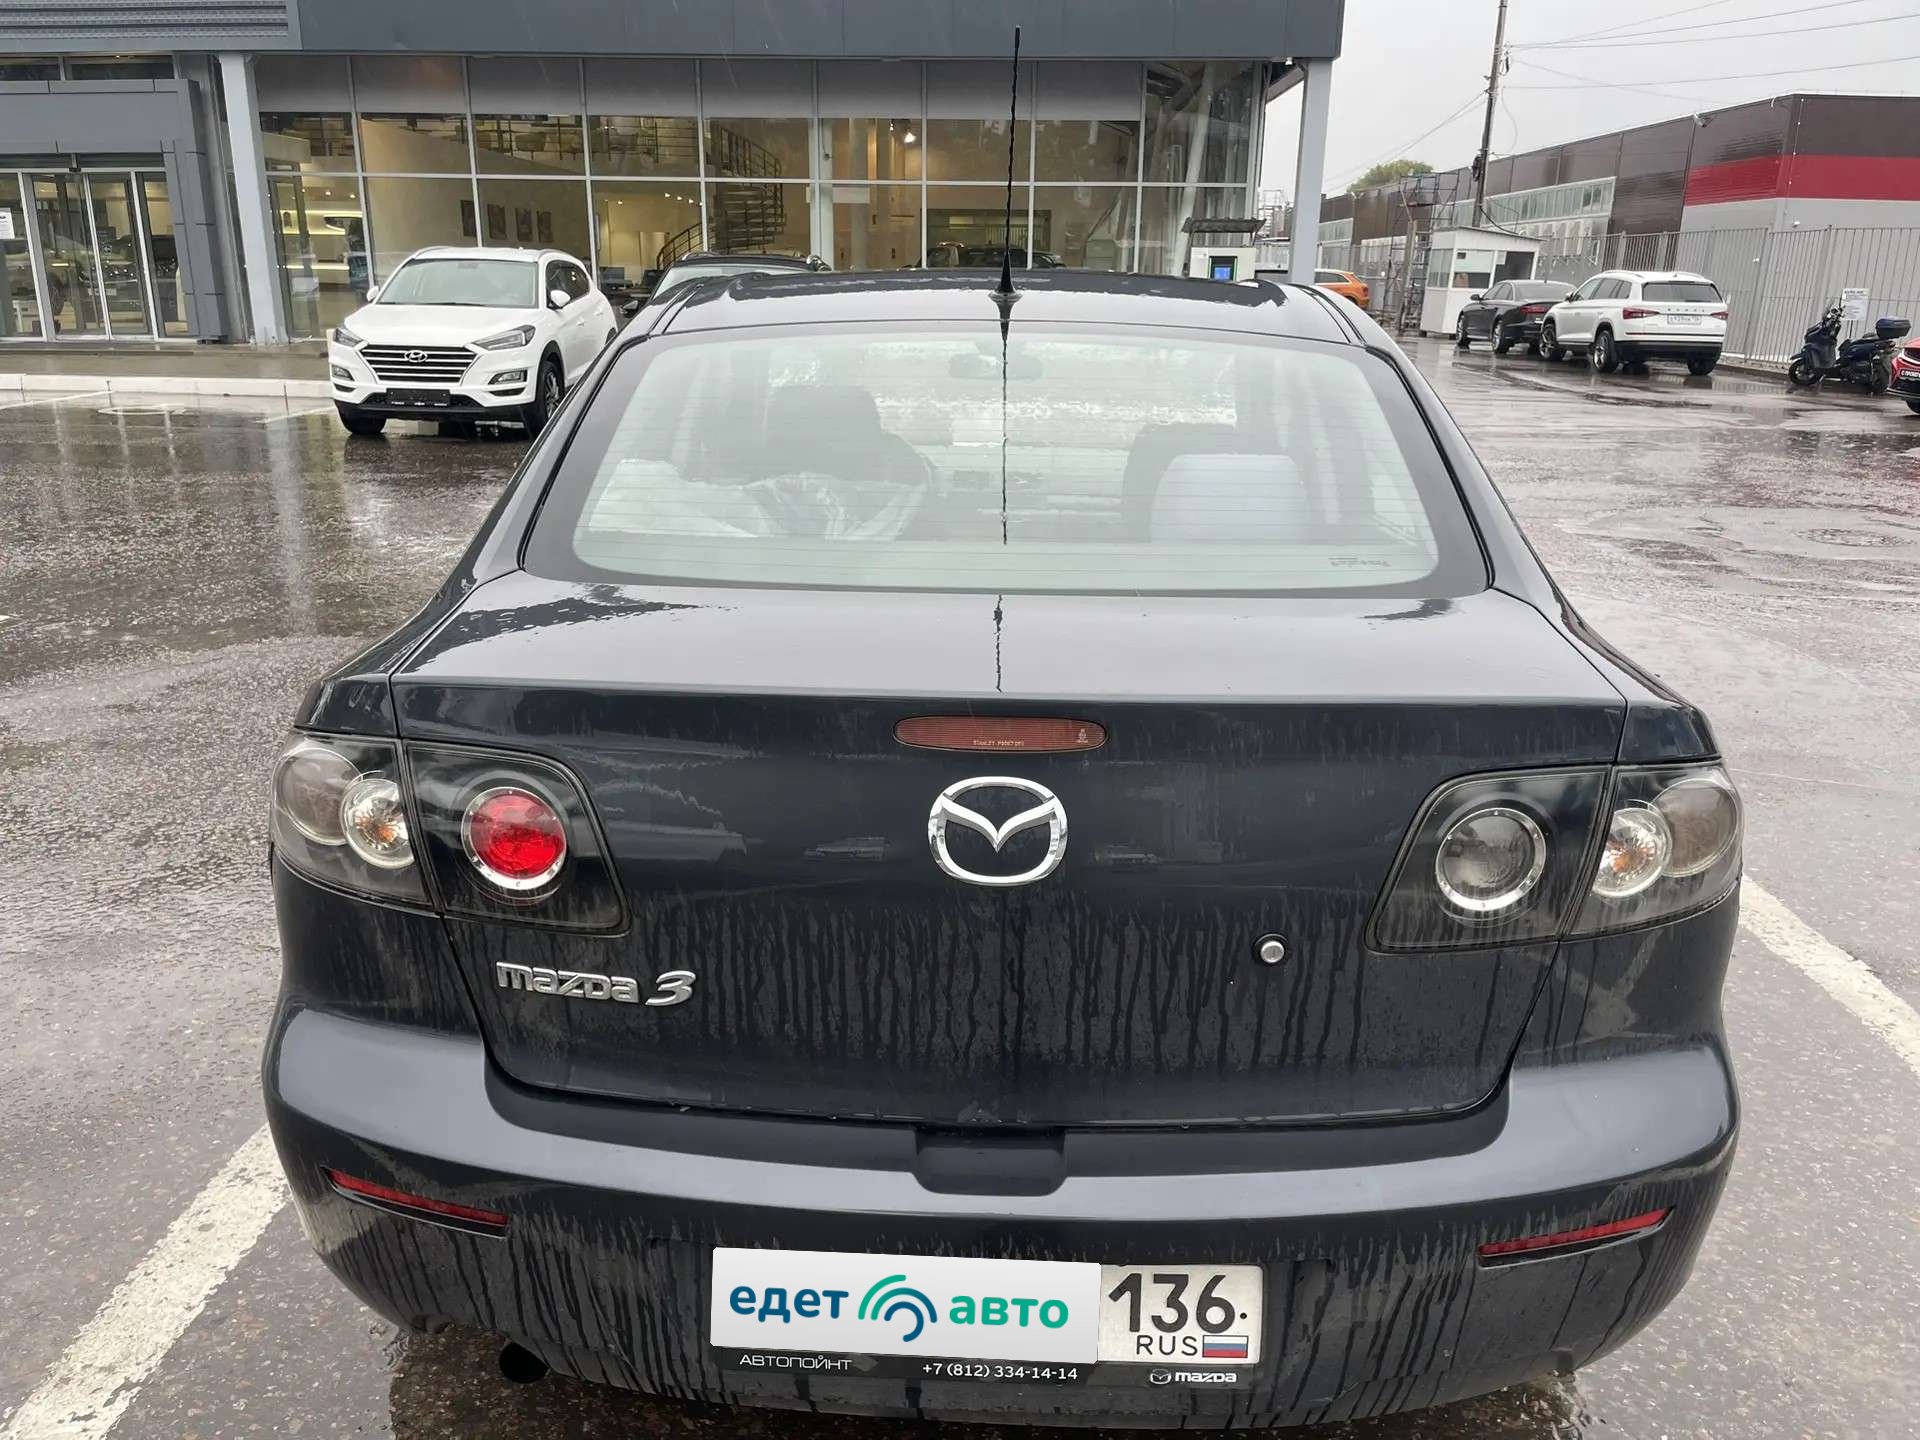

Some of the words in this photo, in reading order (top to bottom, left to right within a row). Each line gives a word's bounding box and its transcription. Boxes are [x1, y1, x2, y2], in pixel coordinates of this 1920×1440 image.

[645, 970, 696, 1006] 3
[1109, 1273, 1236, 1333] 136
[1136, 1335, 1198, 1356] RUS
[739, 1353, 852, 1371] АВТОПОЙНТ
[922, 1362, 943, 1375] +7
[946, 1361, 990, 1379] (812)
[993, 1365, 1078, 1381] 334-14-14
